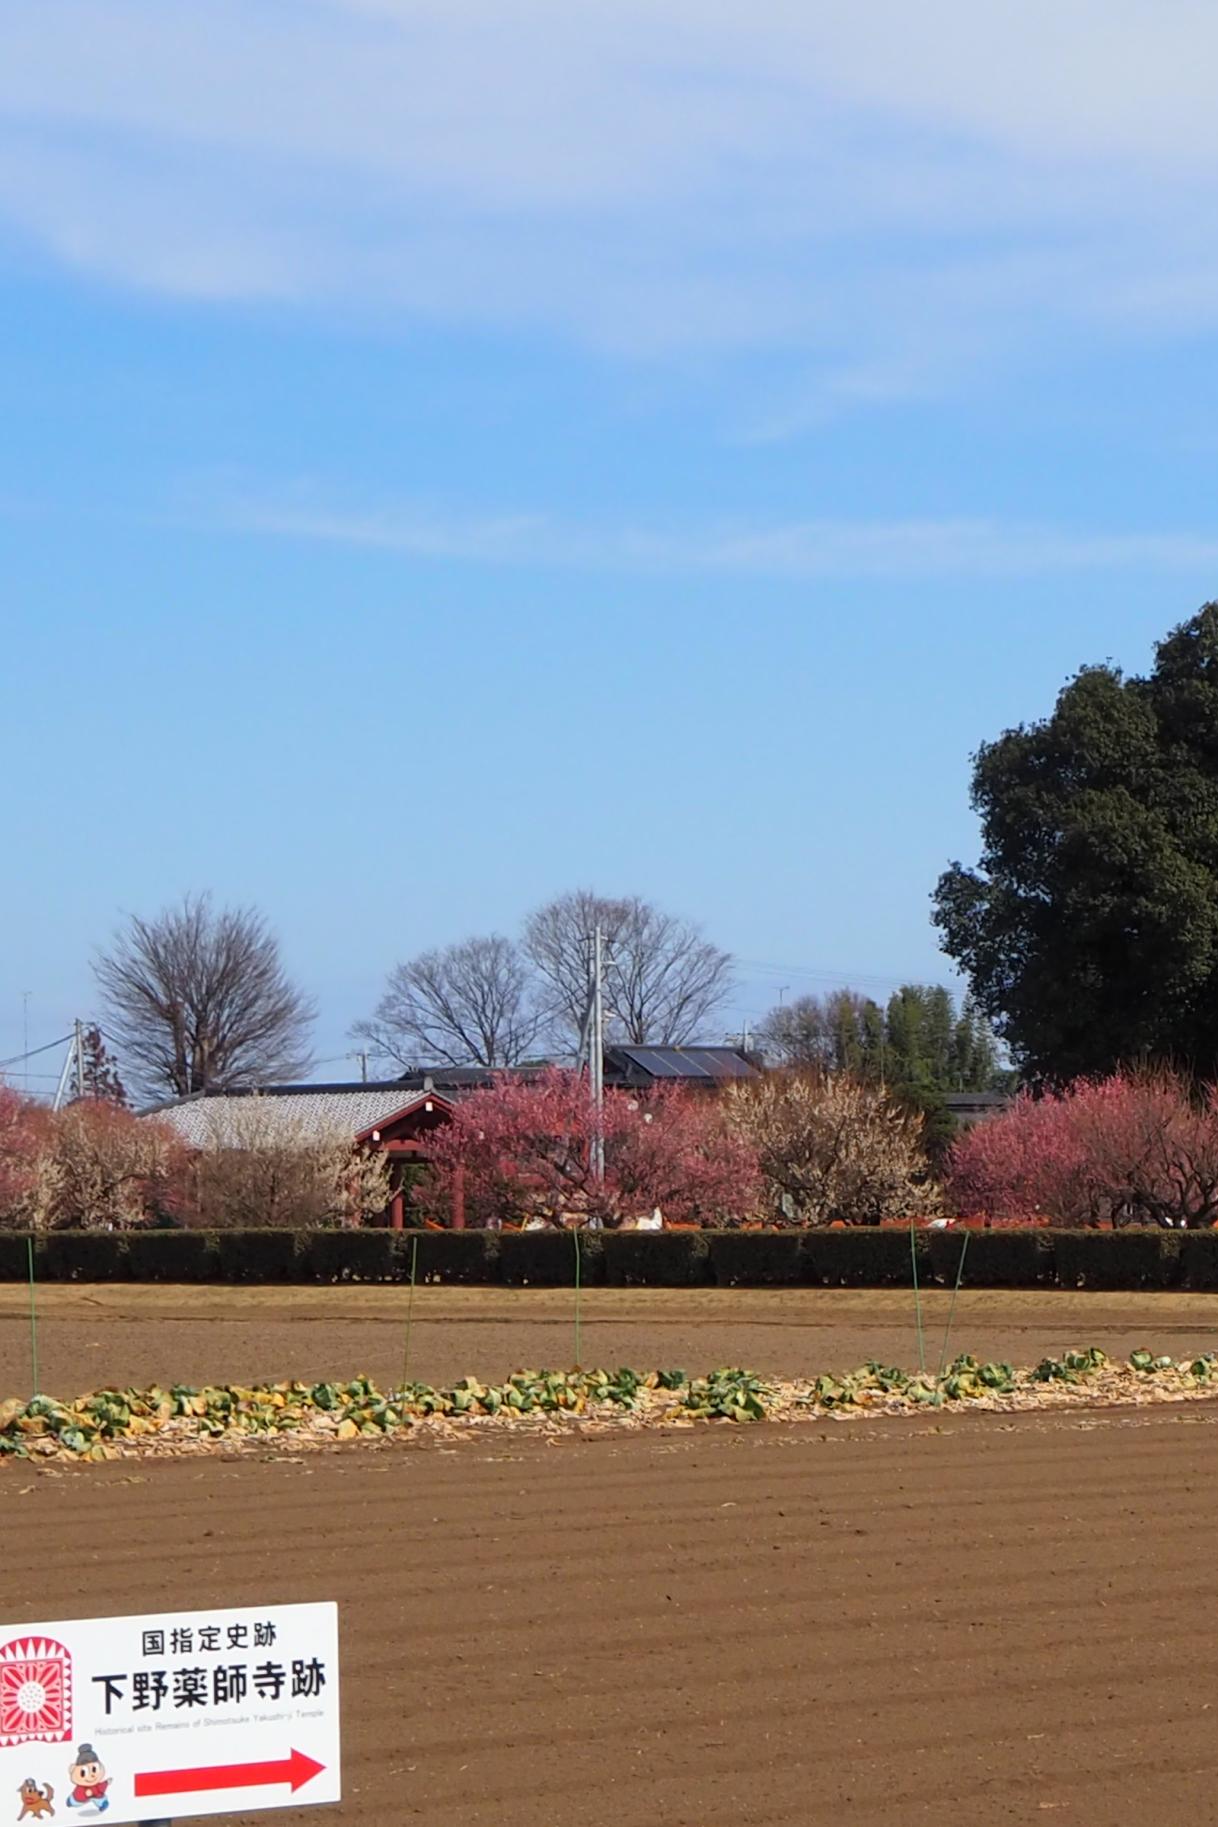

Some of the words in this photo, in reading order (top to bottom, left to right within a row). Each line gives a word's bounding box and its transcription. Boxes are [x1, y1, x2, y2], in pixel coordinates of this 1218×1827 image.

[141, 1621, 277, 1657] 国指定史跡
[91, 1657, 327, 1715] 下野薬師寺跡
[296, 1708, 324, 1719] Temple
